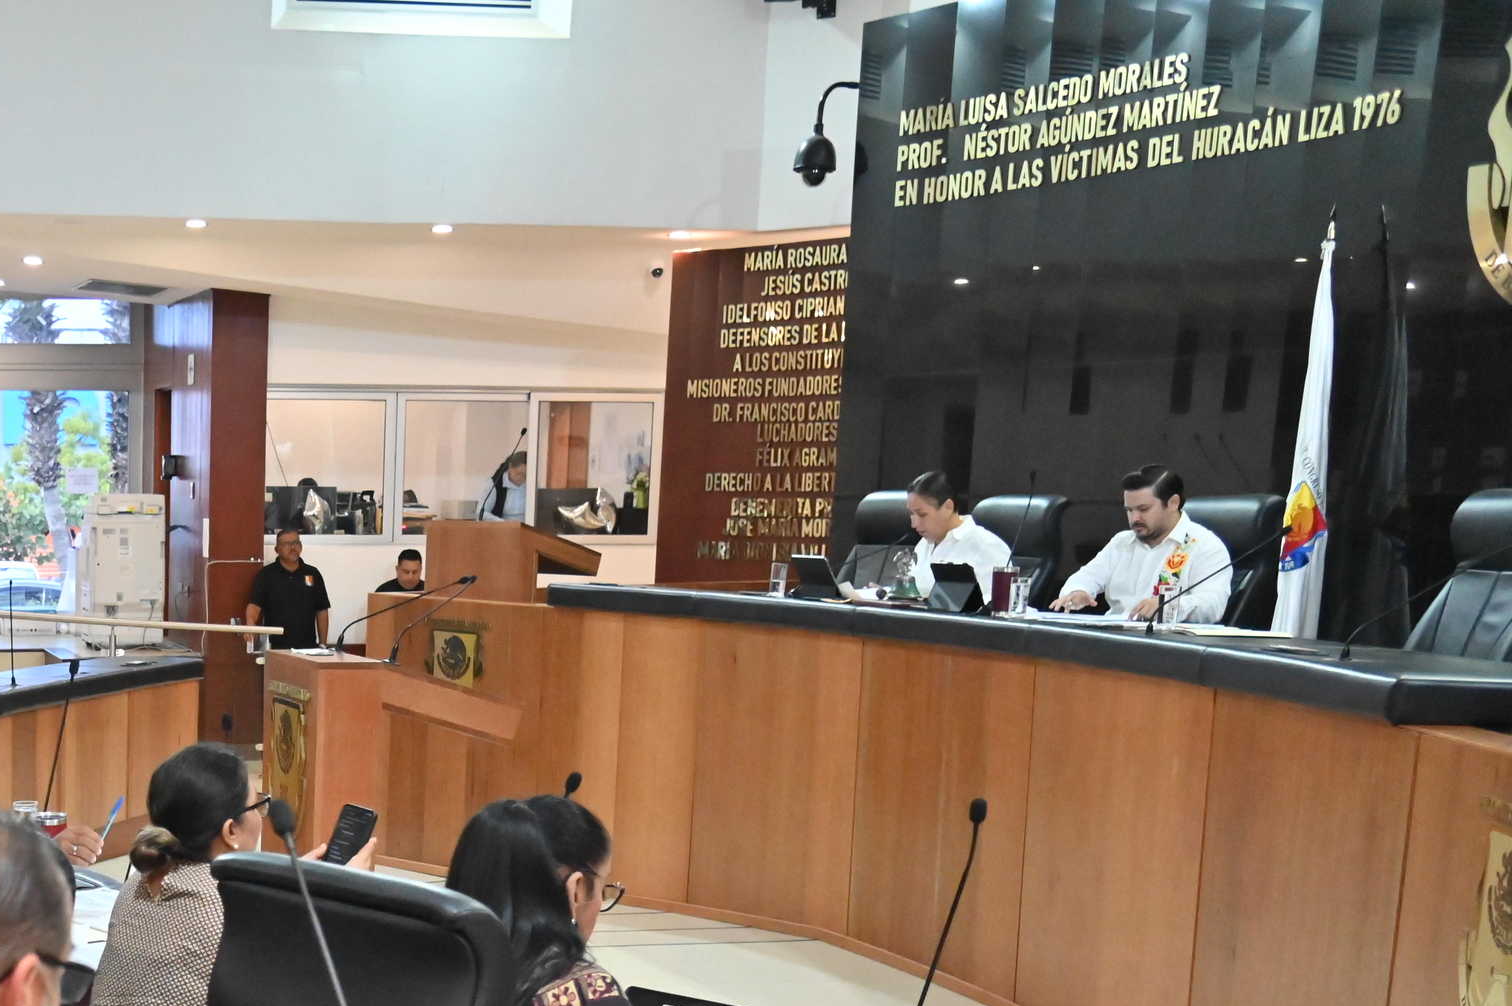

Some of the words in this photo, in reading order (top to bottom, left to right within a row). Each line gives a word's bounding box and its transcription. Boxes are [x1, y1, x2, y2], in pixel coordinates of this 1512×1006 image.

[899, 98, 955, 136] MARÍA
[960, 92, 1008, 126] LUISA
[1013, 74, 1094, 117] SALCEDO
[1098, 52, 1190, 99] MORALES
[896, 138, 947, 172] PROF.
[963, 122, 1032, 161] NÉSTOR
[1036, 106, 1119, 149] AGÚNDEZ
[1122, 80, 1222, 133] MARTÍNEZ
[894, 178, 919, 207] EN
[923, 168, 987, 205] HONOR
[989, 165, 1003, 194] A
[1007, 157, 1045, 191] LAS
[1050, 139, 1139, 184] VÍCTIMAS
[1146, 132, 1184, 168] DEL
[1191, 106, 1292, 161] HURACÁN
[1297, 103, 1346, 143] LIZA
[1352, 89, 1403, 132] 1976
[744, 244, 784, 272] MARÍA
[787, 243, 847, 269] ROSAURA
[761, 270, 801, 296] JESÚS
[723, 300, 791, 325] IDELFONSO
[720, 324, 800, 349] DEFENSORES
[803, 322, 818, 344] DE
[822, 321, 838, 343] LA
[733, 352, 742, 373] A
[745, 351, 769, 373] LOS
[772, 348, 844, 371] CONSTITUY
[687, 376, 762, 399] MISIONEROS
[713, 402, 732, 423] DR.
[736, 401, 805, 423] FRANCISCO
[756, 422, 838, 443] LUCHADORES
[705, 473, 761, 492] DERECHO
[763, 473, 772, 492] A
[776, 472, 791, 492] LA
